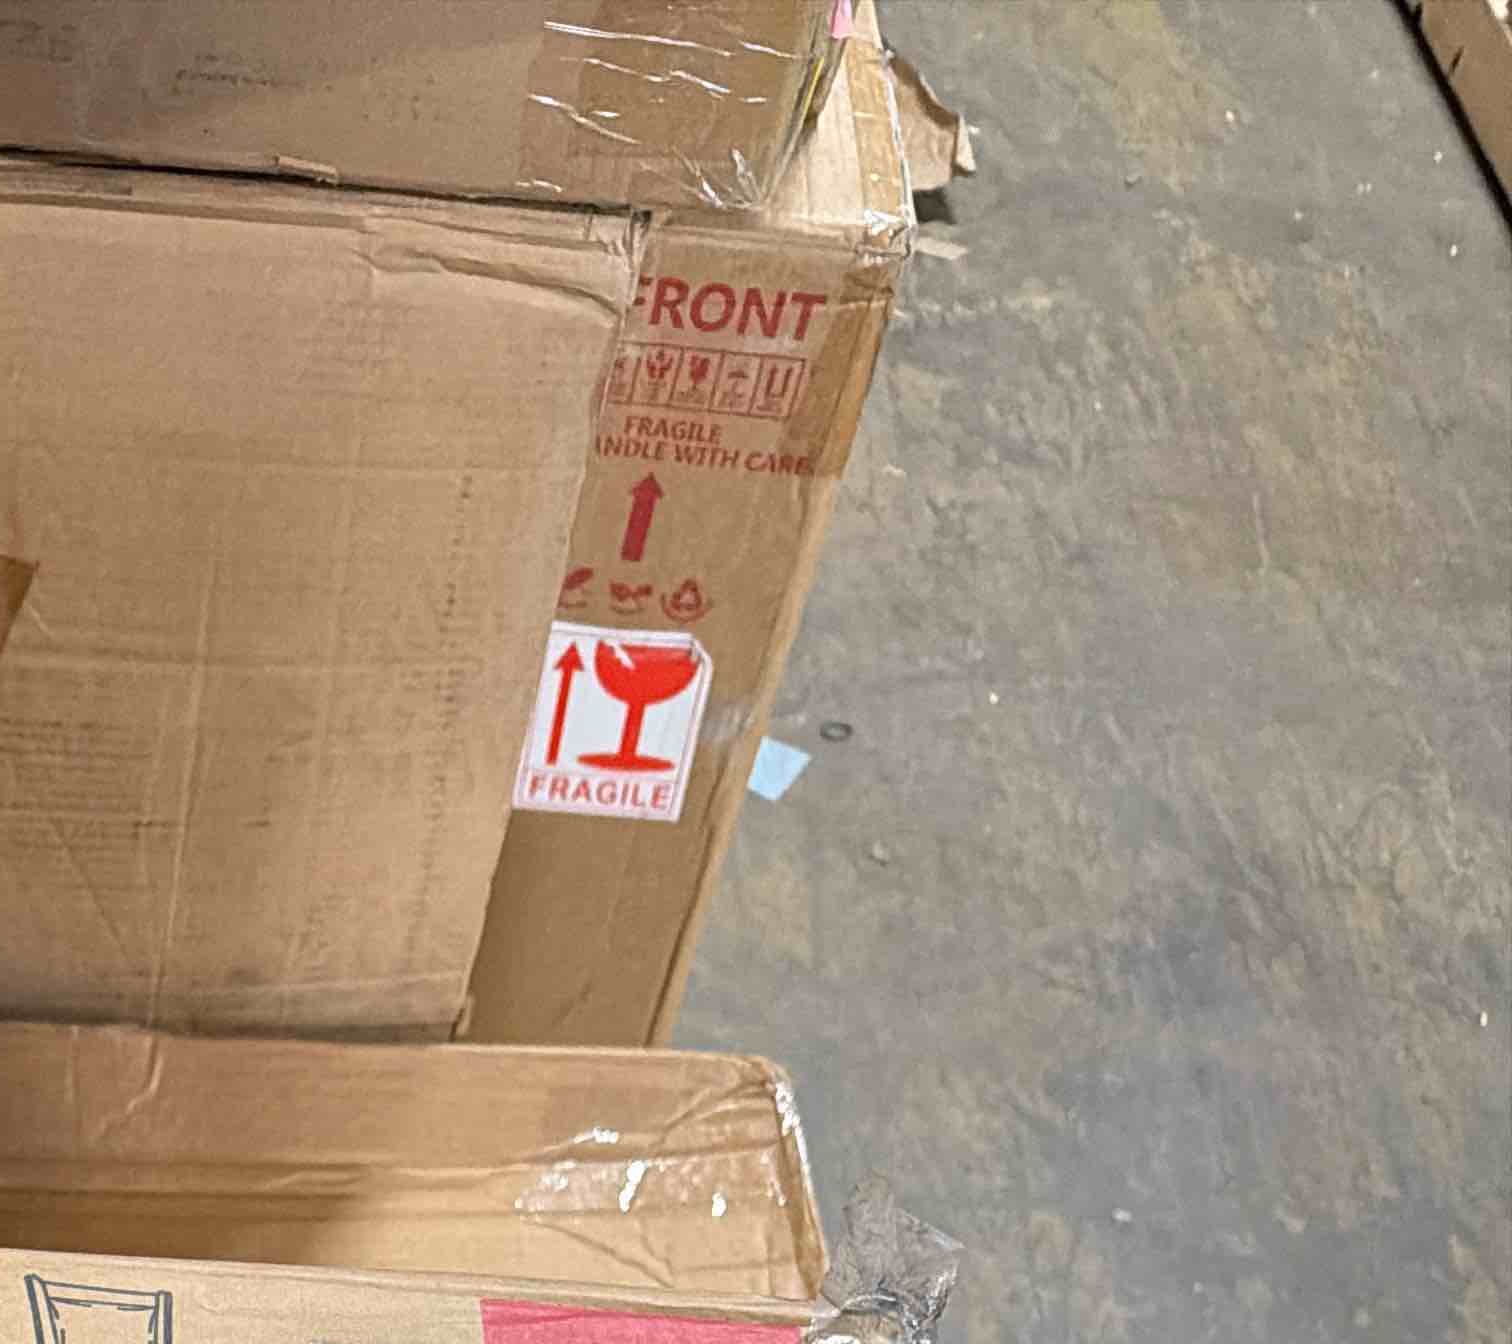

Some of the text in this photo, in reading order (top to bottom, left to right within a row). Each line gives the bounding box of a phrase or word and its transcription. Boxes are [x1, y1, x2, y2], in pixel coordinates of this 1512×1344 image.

[634, 274, 827, 341] RONT
[624, 416, 723, 444] FRAGILE
[595, 434, 665, 462] NDLE
[673, 444, 740, 468] WITH
[528, 774, 672, 809] FRAGILE
